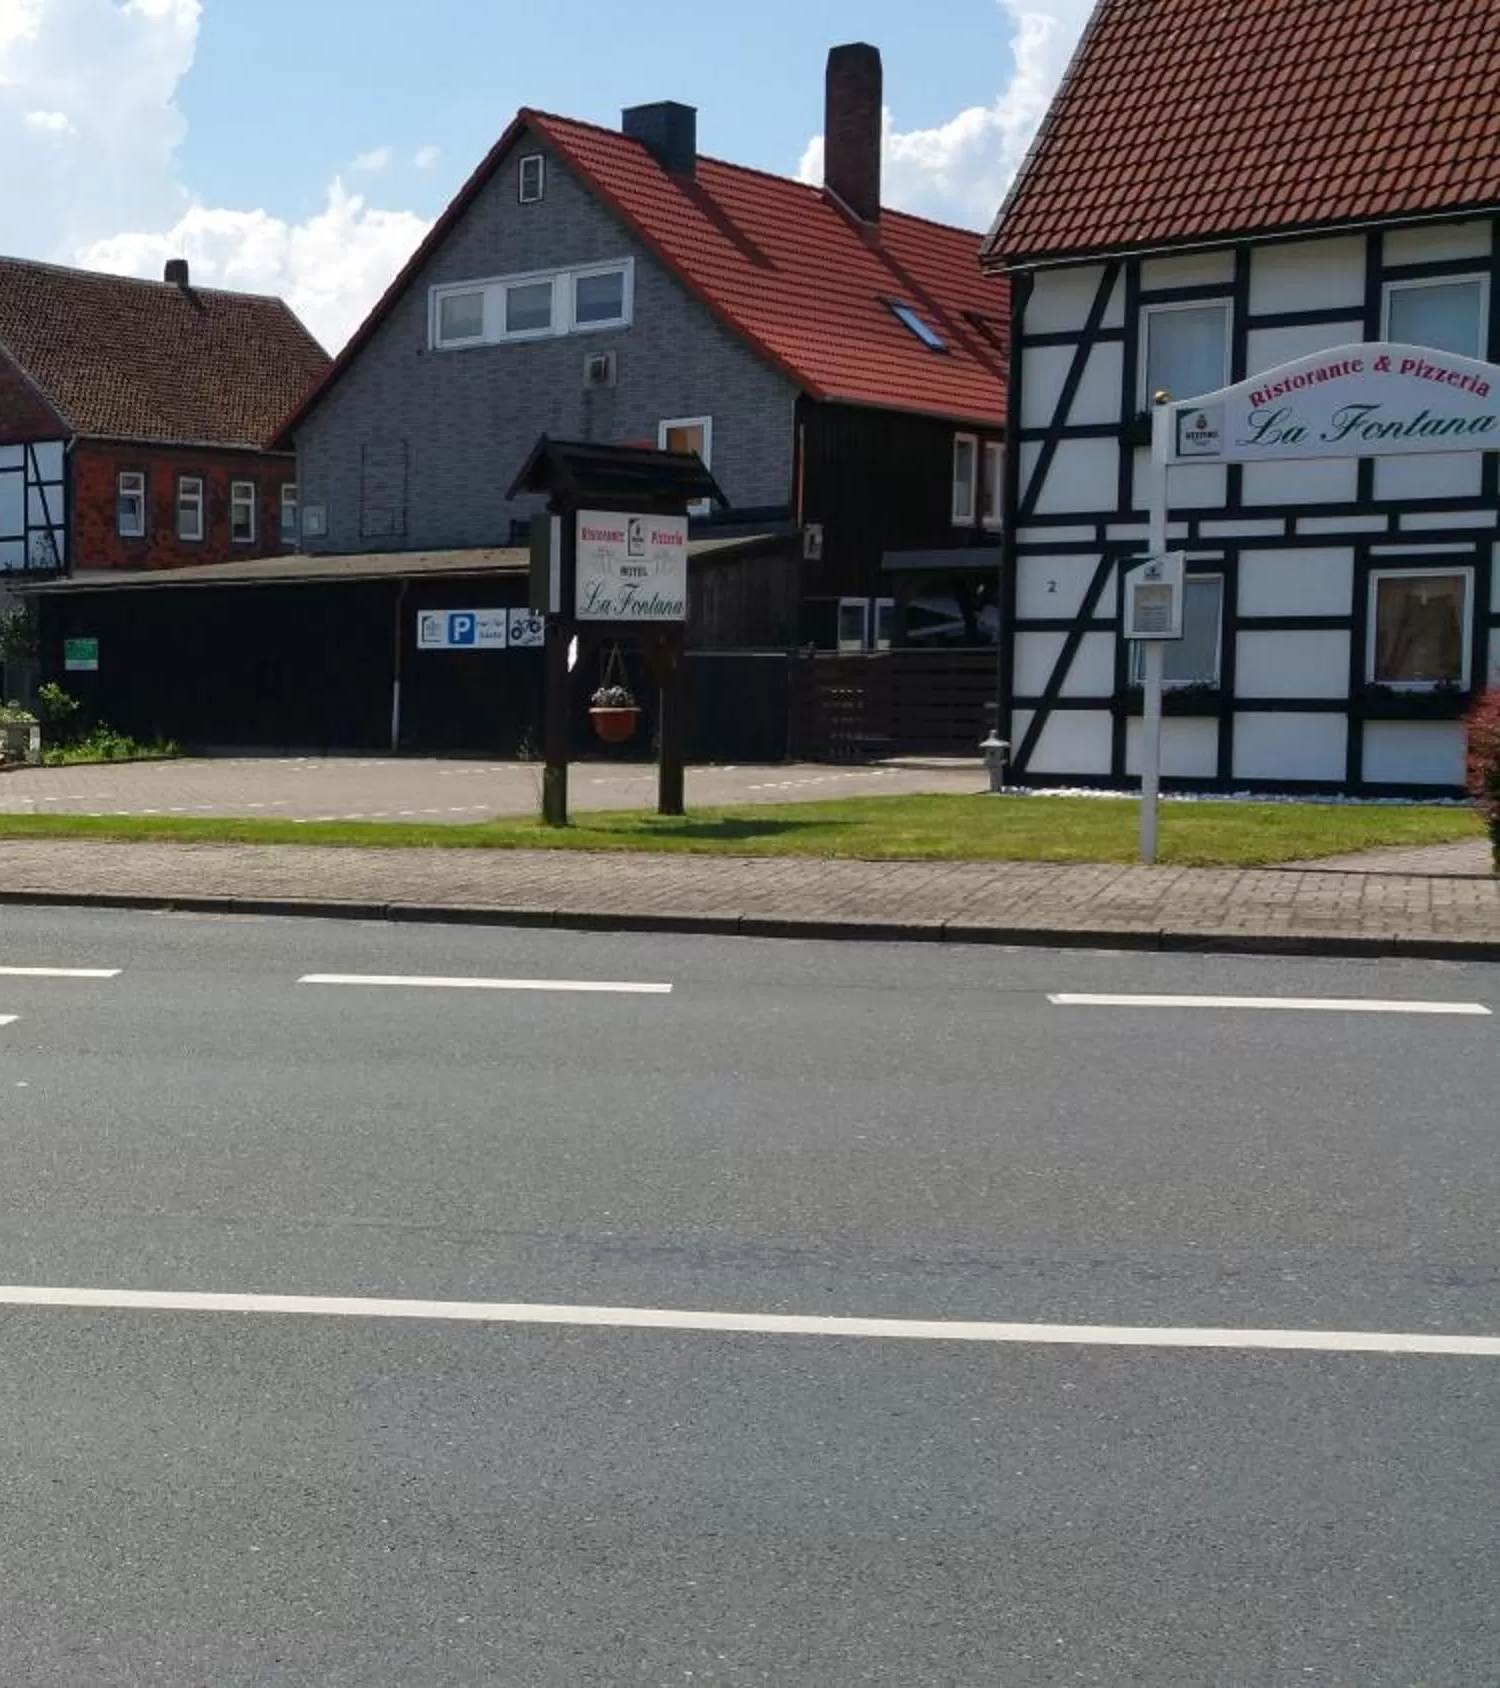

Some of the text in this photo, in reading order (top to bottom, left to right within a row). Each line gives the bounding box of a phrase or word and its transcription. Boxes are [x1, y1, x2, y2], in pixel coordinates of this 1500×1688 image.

[1249, 355, 1491, 408] Ristorante & Pizzeria
[1236, 403, 1497, 446] La Fontana
[580, 578, 684, 615] La Fontana
[1047, 579, 1058, 593] 2
[453, 616, 471, 641] P
